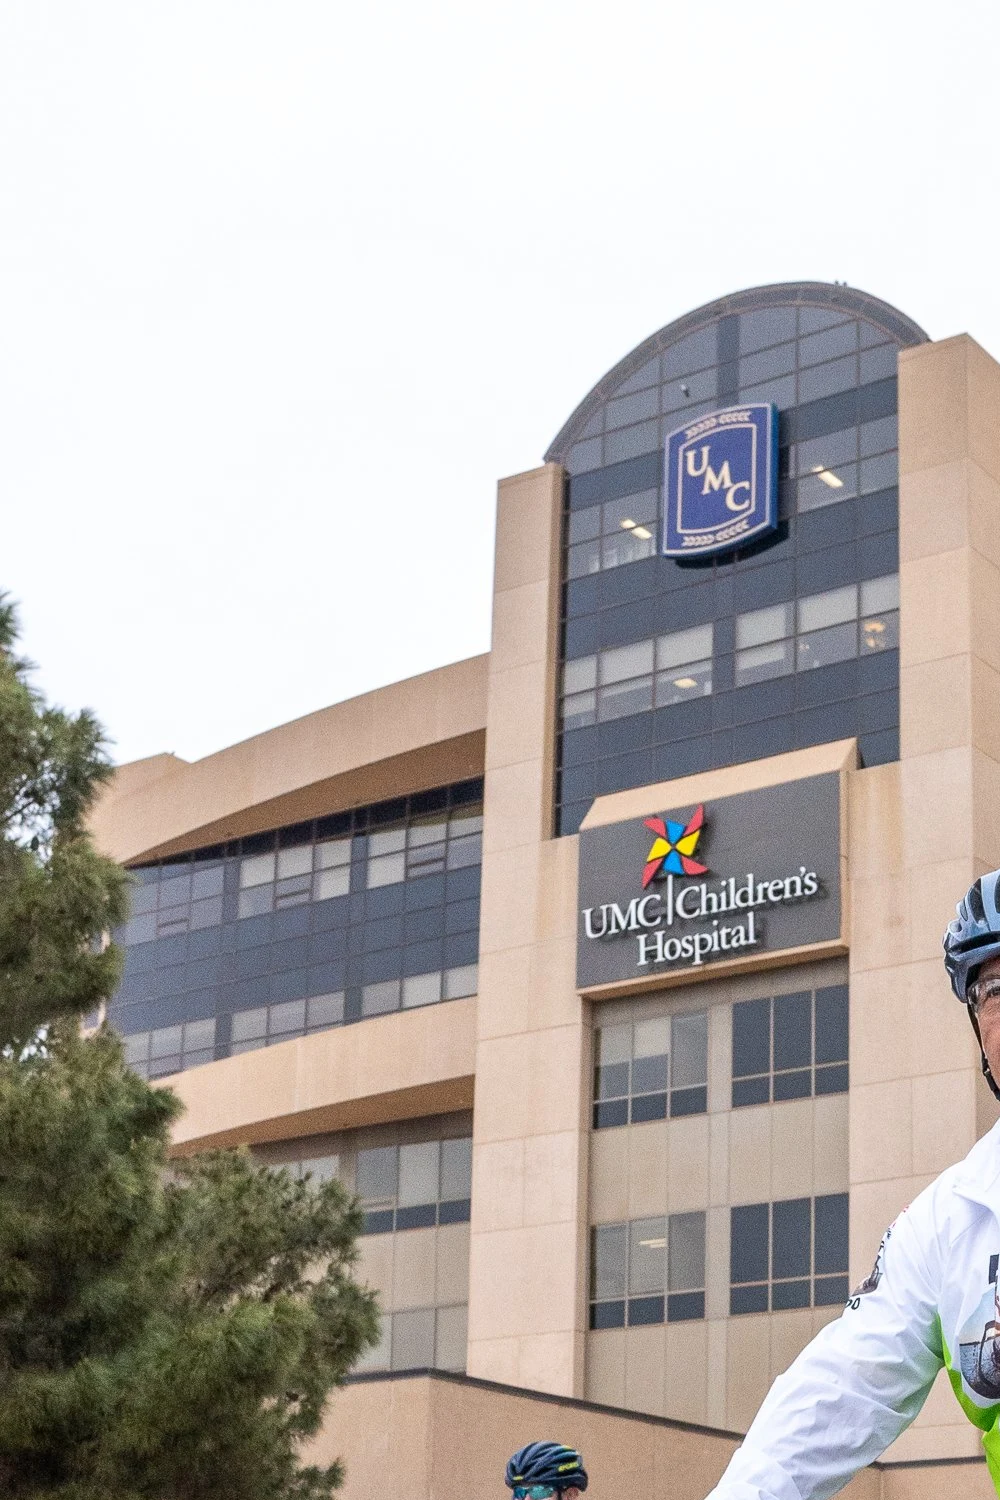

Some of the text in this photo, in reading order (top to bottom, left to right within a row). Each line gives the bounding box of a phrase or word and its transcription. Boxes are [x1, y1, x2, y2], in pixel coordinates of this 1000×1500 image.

[686, 446, 750, 511] UMC
[582, 867, 818, 939] UMC Children's
[636, 911, 757, 966] Hospital
